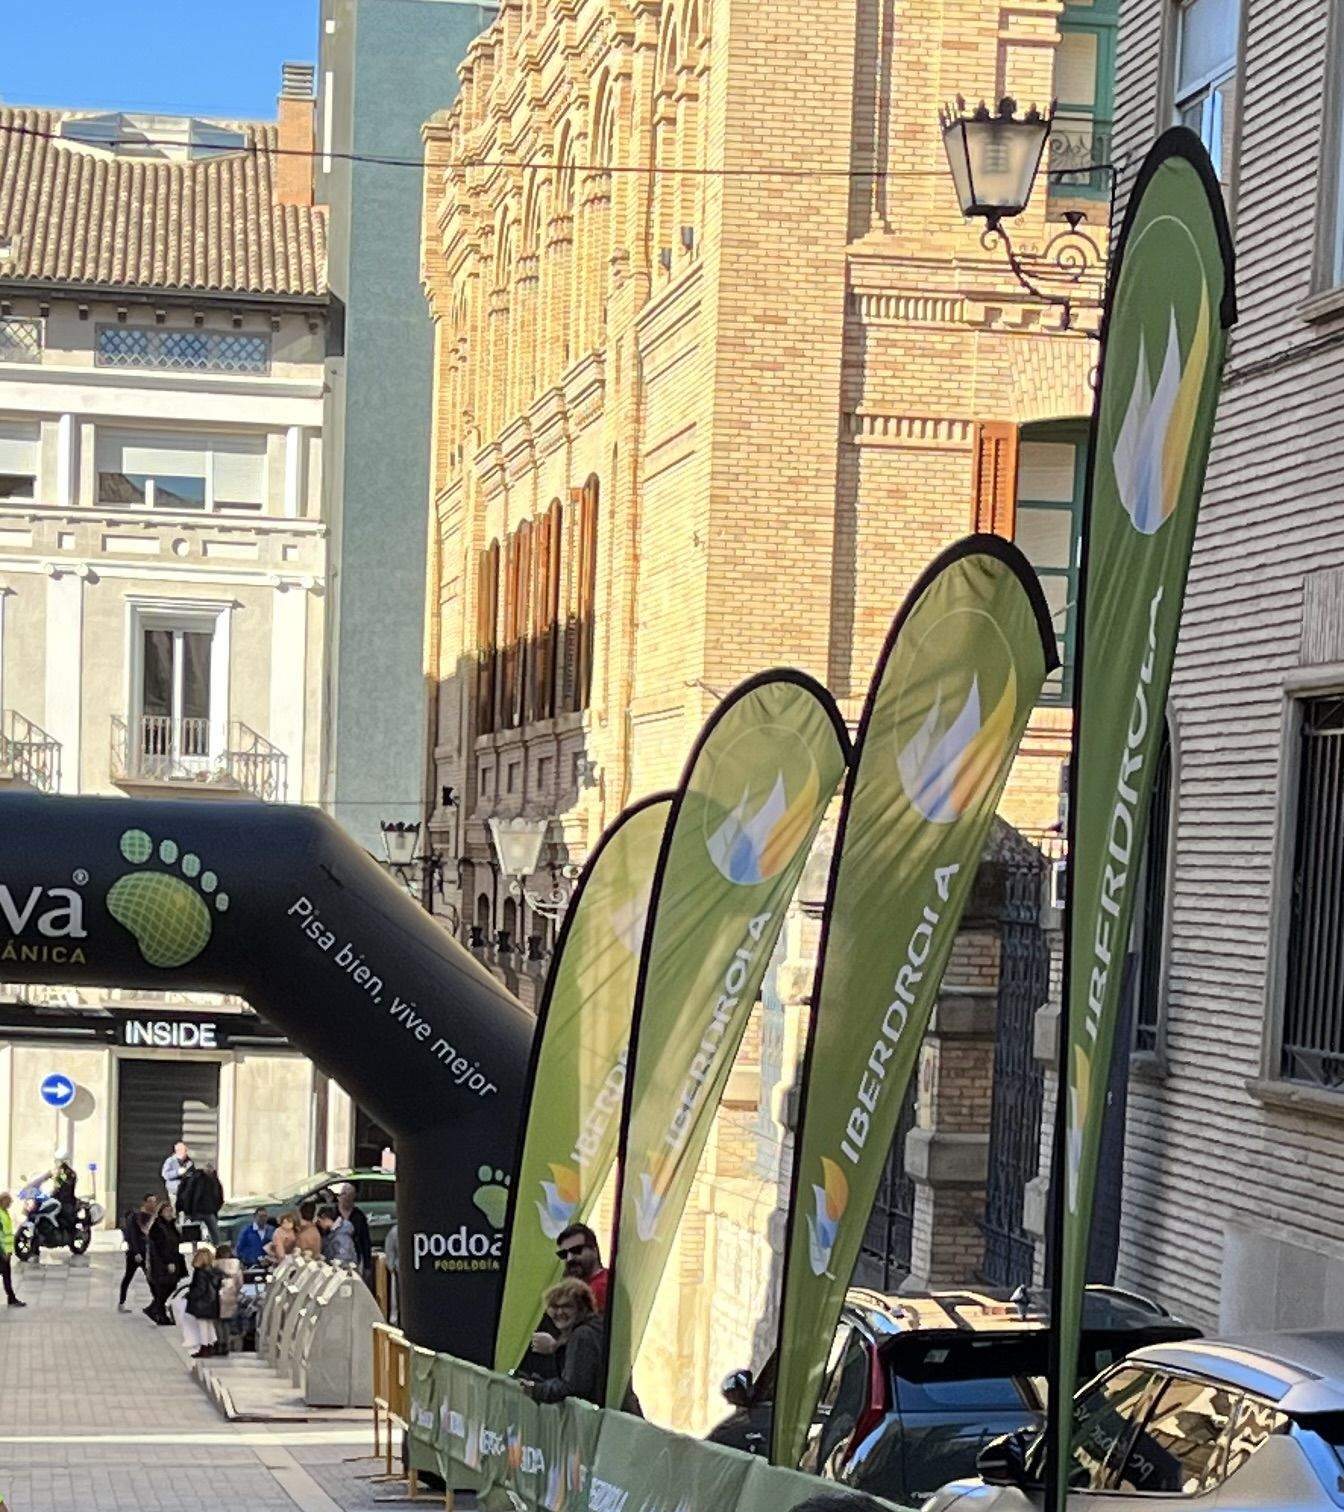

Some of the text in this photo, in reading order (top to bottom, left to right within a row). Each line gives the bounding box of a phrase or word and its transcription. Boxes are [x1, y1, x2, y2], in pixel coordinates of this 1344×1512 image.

[125, 1020, 217, 1048] INSIDE
[287, 896, 498, 1096] Pisa bien, vive mejor
